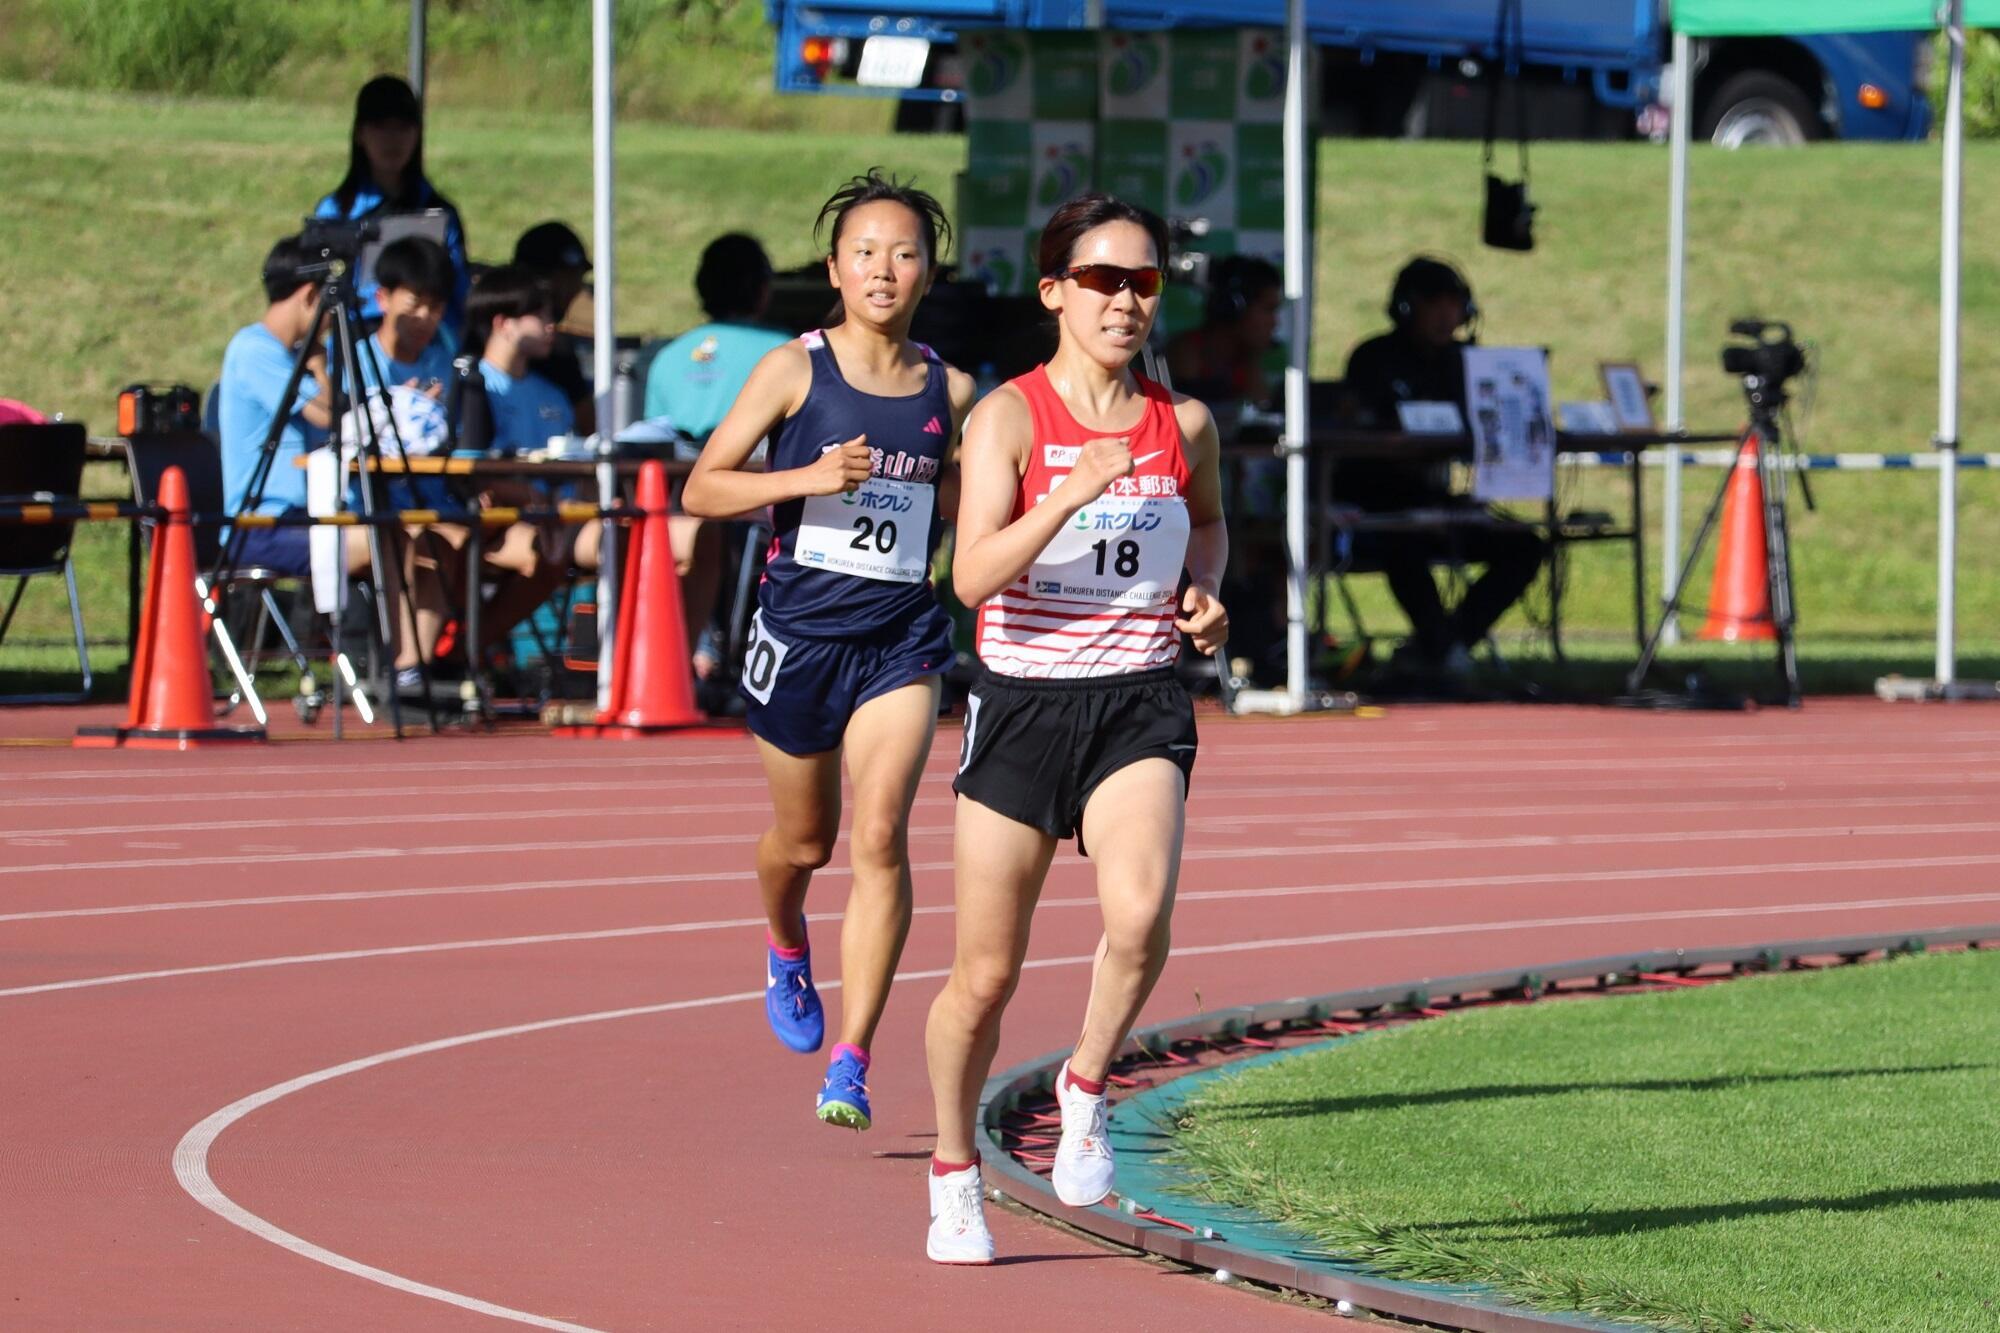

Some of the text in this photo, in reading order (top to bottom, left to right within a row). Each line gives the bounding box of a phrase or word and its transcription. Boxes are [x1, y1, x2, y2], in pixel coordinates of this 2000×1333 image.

[859, 491, 913, 513] ホクレン
[1094, 512, 1162, 531] ホクレン
[849, 515, 897, 554] 20
[856, 562, 884, 575] DISTANCE
[1092, 539, 1140, 578] 18
[1063, 586, 1094, 596] HOKUREN
[1096, 588, 1127, 599] DISTANCE
